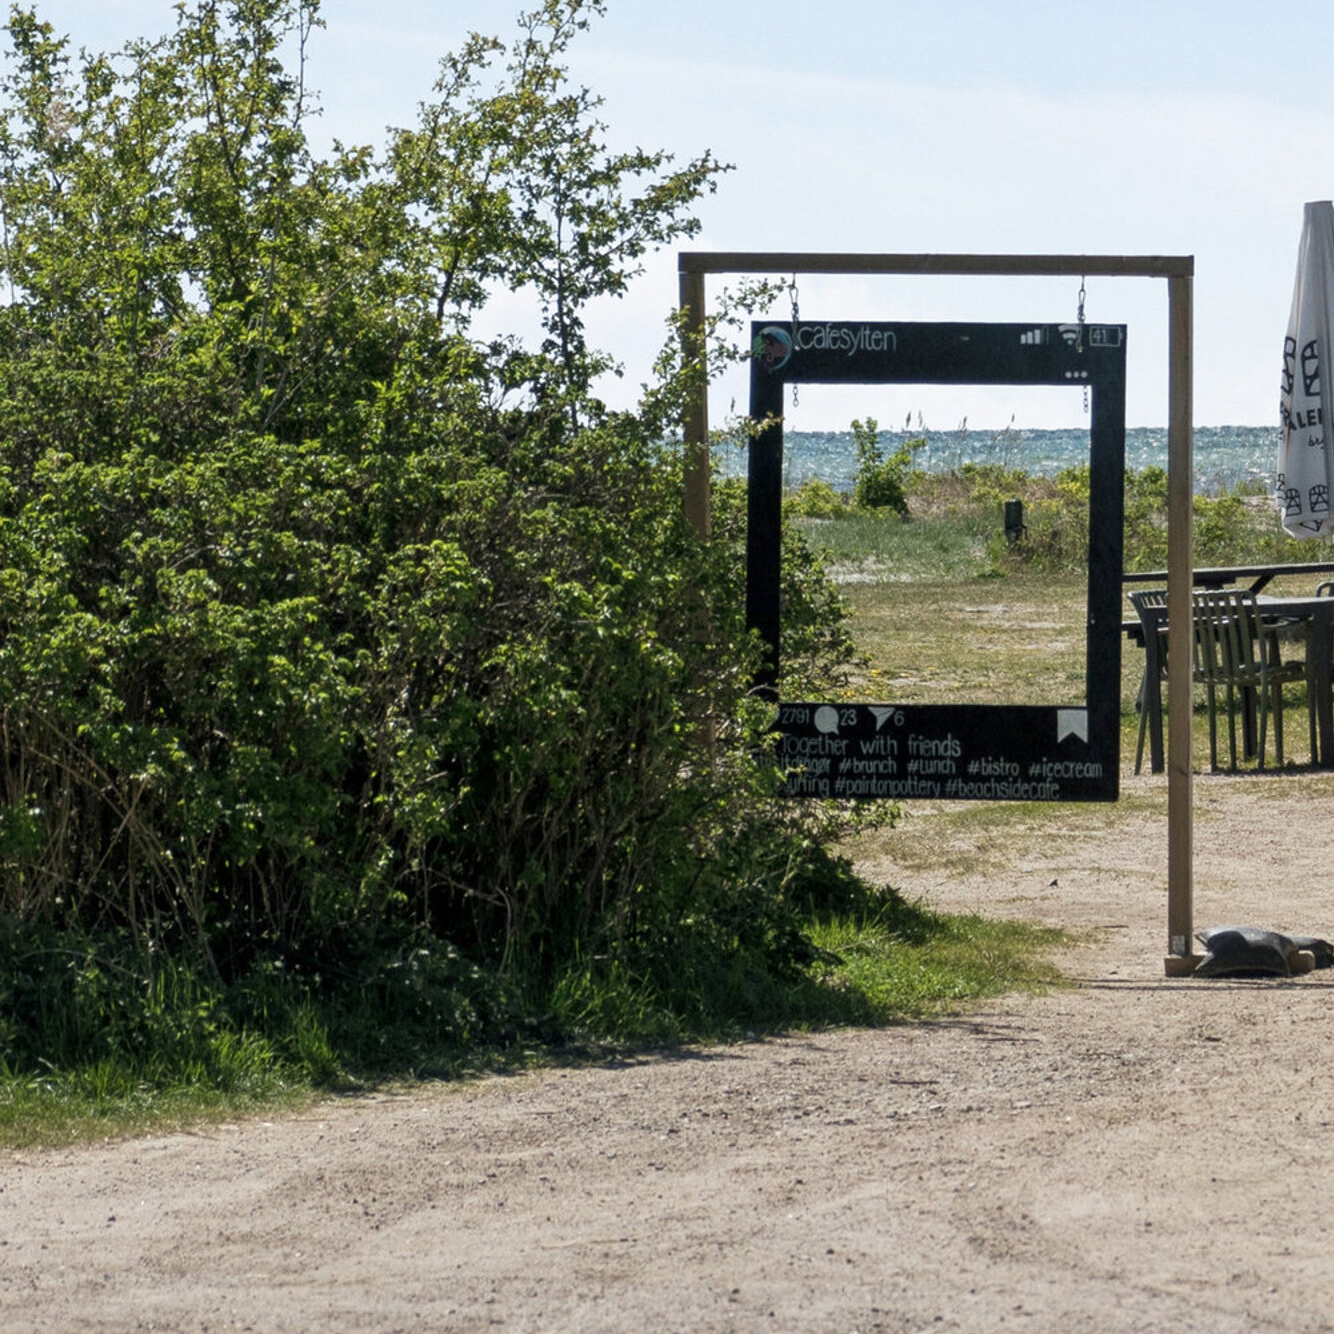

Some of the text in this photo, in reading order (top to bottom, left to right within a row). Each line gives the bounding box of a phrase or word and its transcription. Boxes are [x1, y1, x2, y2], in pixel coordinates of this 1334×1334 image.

[1093, 328, 1107, 343] 41
[782, 708, 905, 726] 2791 23 6
[782, 733, 961, 757] Together with friends
[838, 757, 896, 774] #brunch
[968, 756, 1020, 776] #bistro
[1028, 757, 1103, 778] #icecream
[835, 775, 941, 798] #paintonpottery
[945, 776, 1060, 799] #beachsidecafe
